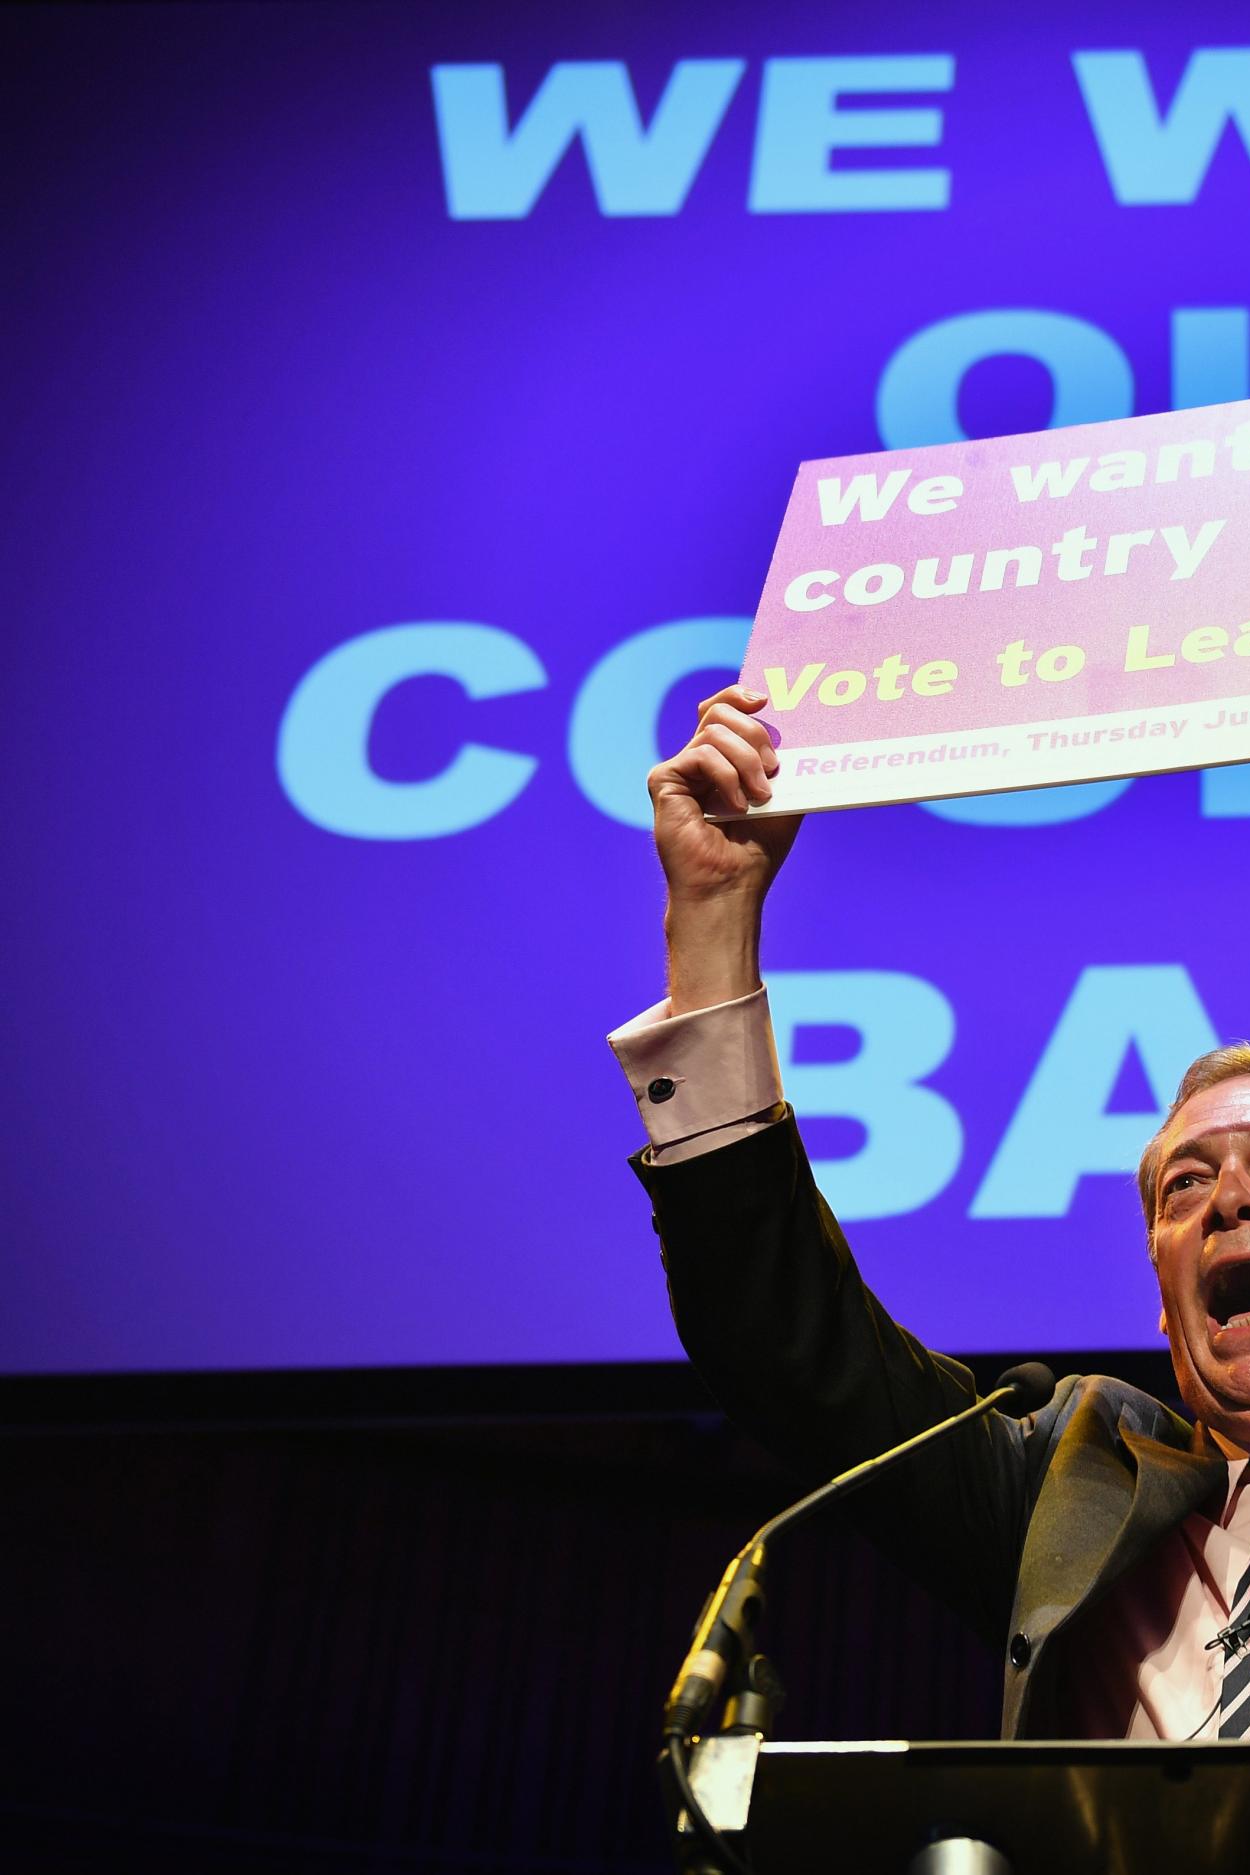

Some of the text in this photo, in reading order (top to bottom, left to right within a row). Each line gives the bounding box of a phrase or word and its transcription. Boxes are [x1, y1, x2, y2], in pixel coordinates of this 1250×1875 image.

[430, 53, 955, 220] WE
[816, 468, 964, 527] We
[783, 519, 1229, 612] country
[763, 653, 959, 713] Vote
[995, 639, 1087, 688] to
[794, 741, 1011, 778] Referendum,
[1025, 717, 1189, 752] Thursday
